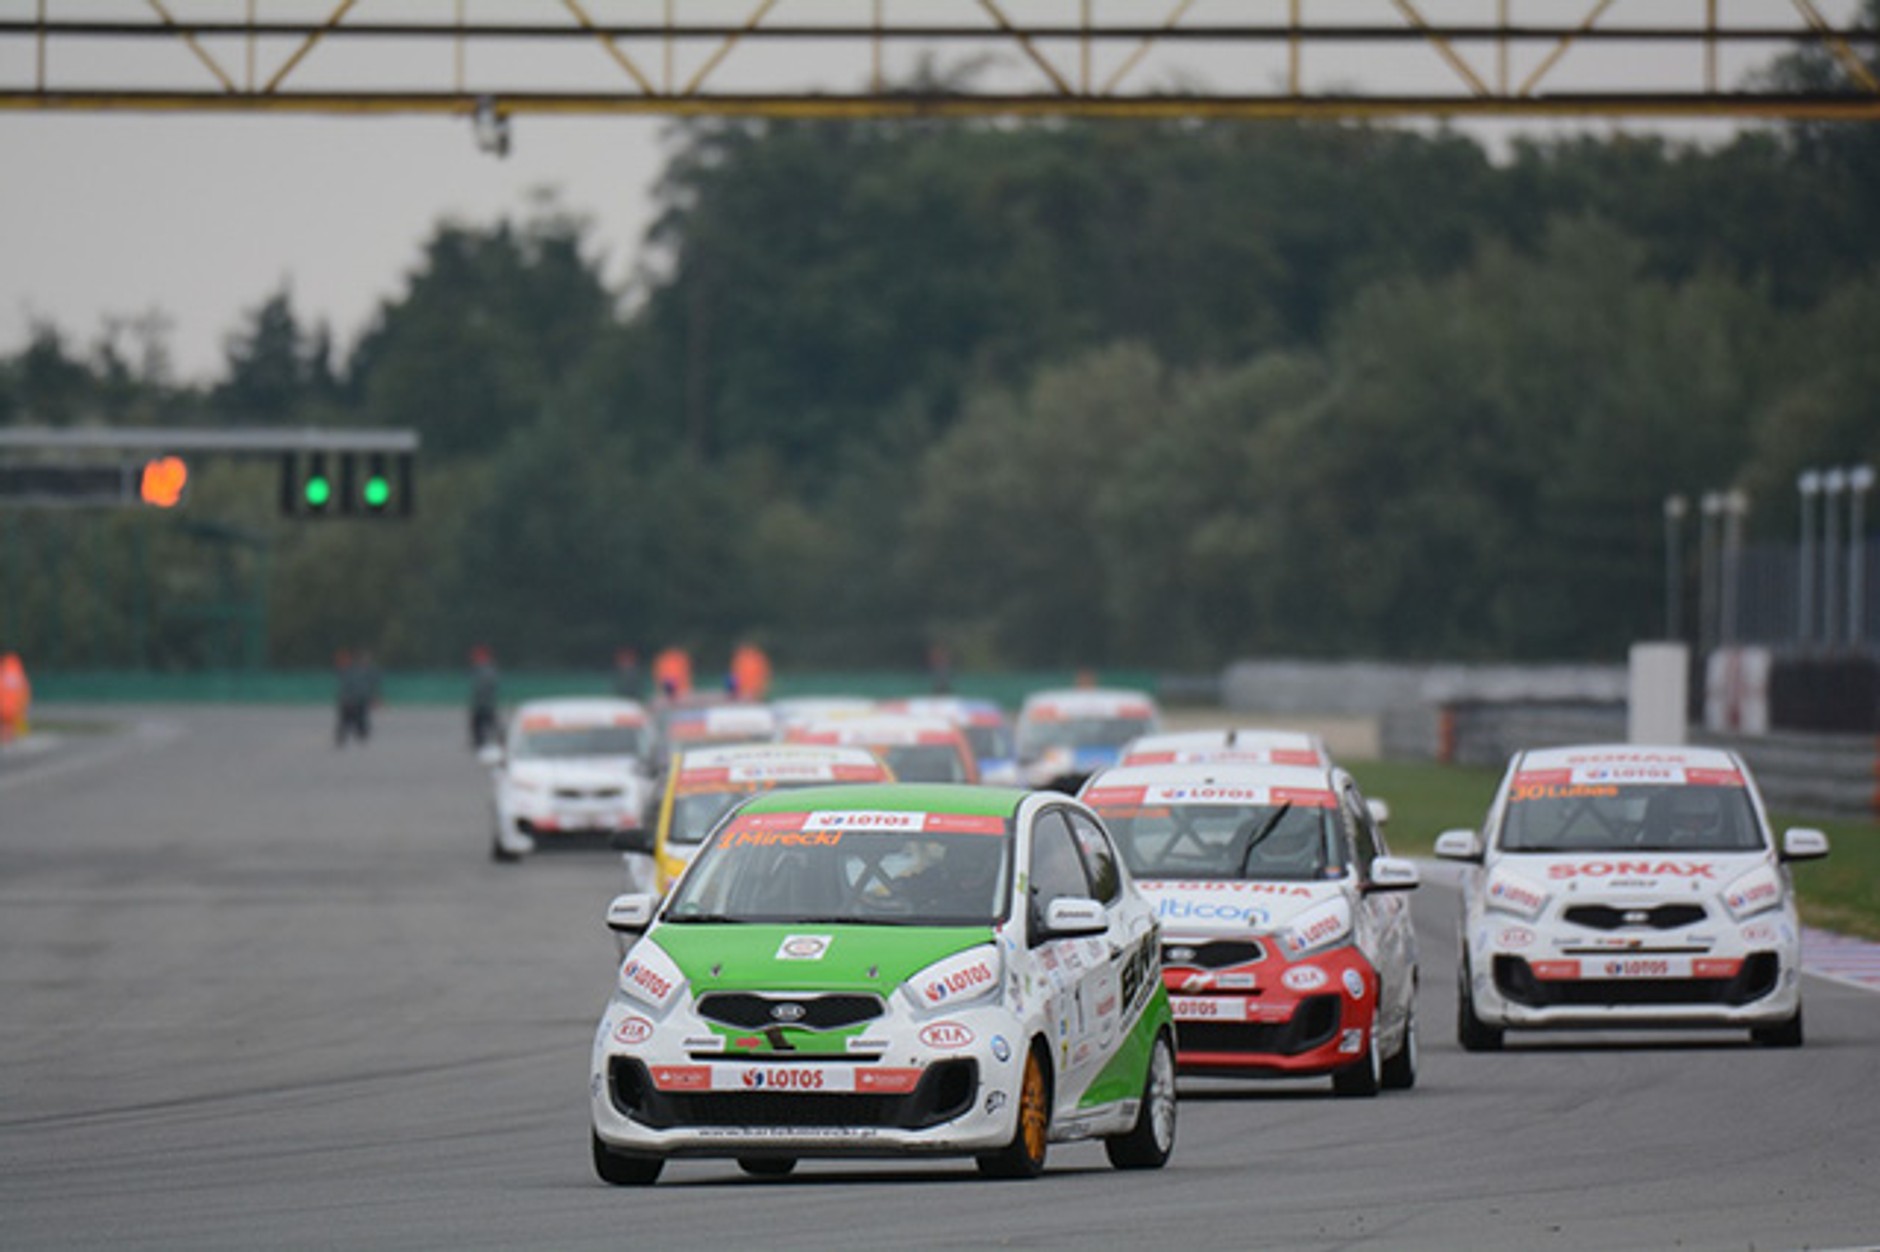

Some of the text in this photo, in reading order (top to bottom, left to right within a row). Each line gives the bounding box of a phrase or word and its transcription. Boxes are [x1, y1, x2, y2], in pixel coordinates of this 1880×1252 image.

[1613, 768, 1671, 778] LOTOS
[1190, 788, 1255, 798] LOTOS
[847, 815, 910, 826] LOTOS
[1547, 861, 1716, 880] SONAX
[1153, 898, 1270, 923] lticon
[1303, 915, 1342, 943] LOTOS
[1623, 960, 1669, 976] LOTOS
[633, 964, 673, 999] LOTOS
[943, 962, 993, 993] LOTOS
[1169, 1001, 1218, 1016] LOTOS
[929, 1028, 966, 1043] KIA
[766, 1069, 824, 1089] LOTOS
